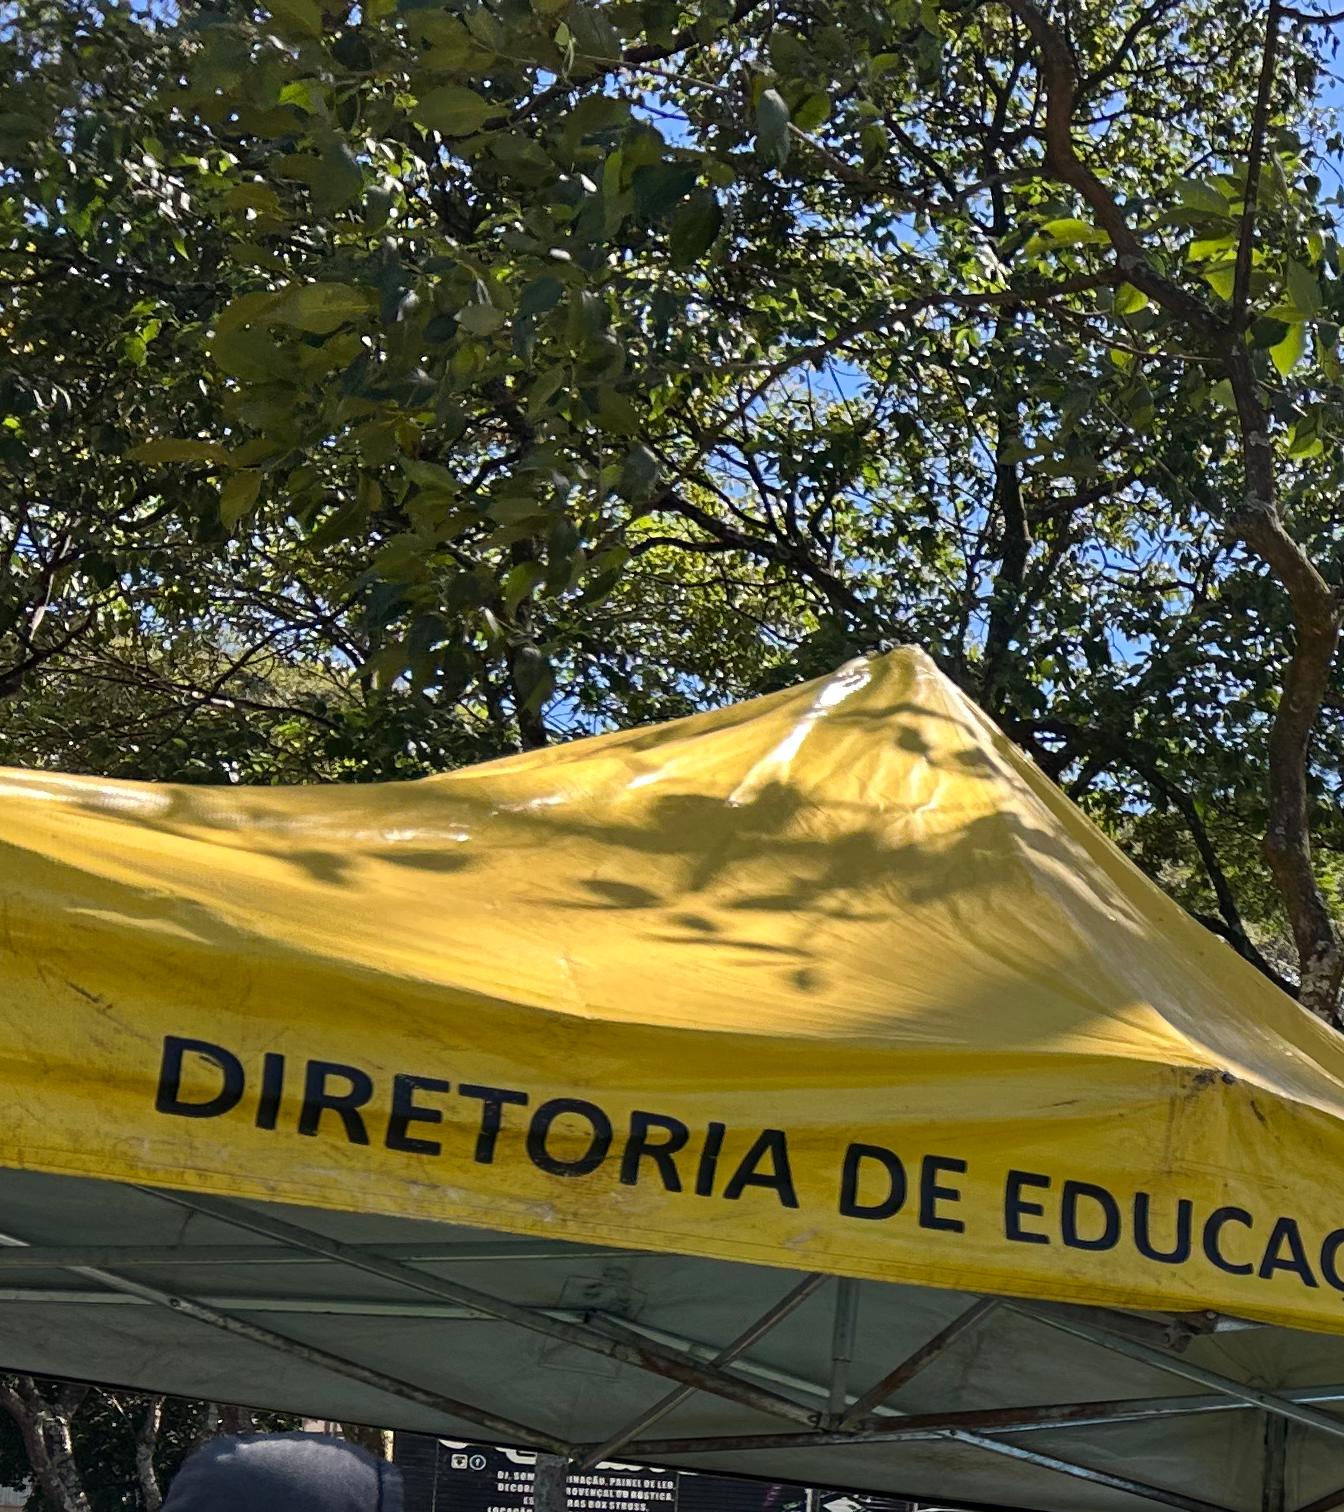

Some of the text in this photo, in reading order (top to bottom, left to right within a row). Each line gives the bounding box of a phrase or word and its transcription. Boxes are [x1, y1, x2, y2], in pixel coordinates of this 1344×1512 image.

[154, 1034, 800, 1209] DIRETORIA
[838, 1142, 968, 1233] DE
[609, 1476, 642, 1488] PAINEL
[644, 1478, 656, 1489] DE
[566, 1487, 614, 1499] ROVENÇAL
